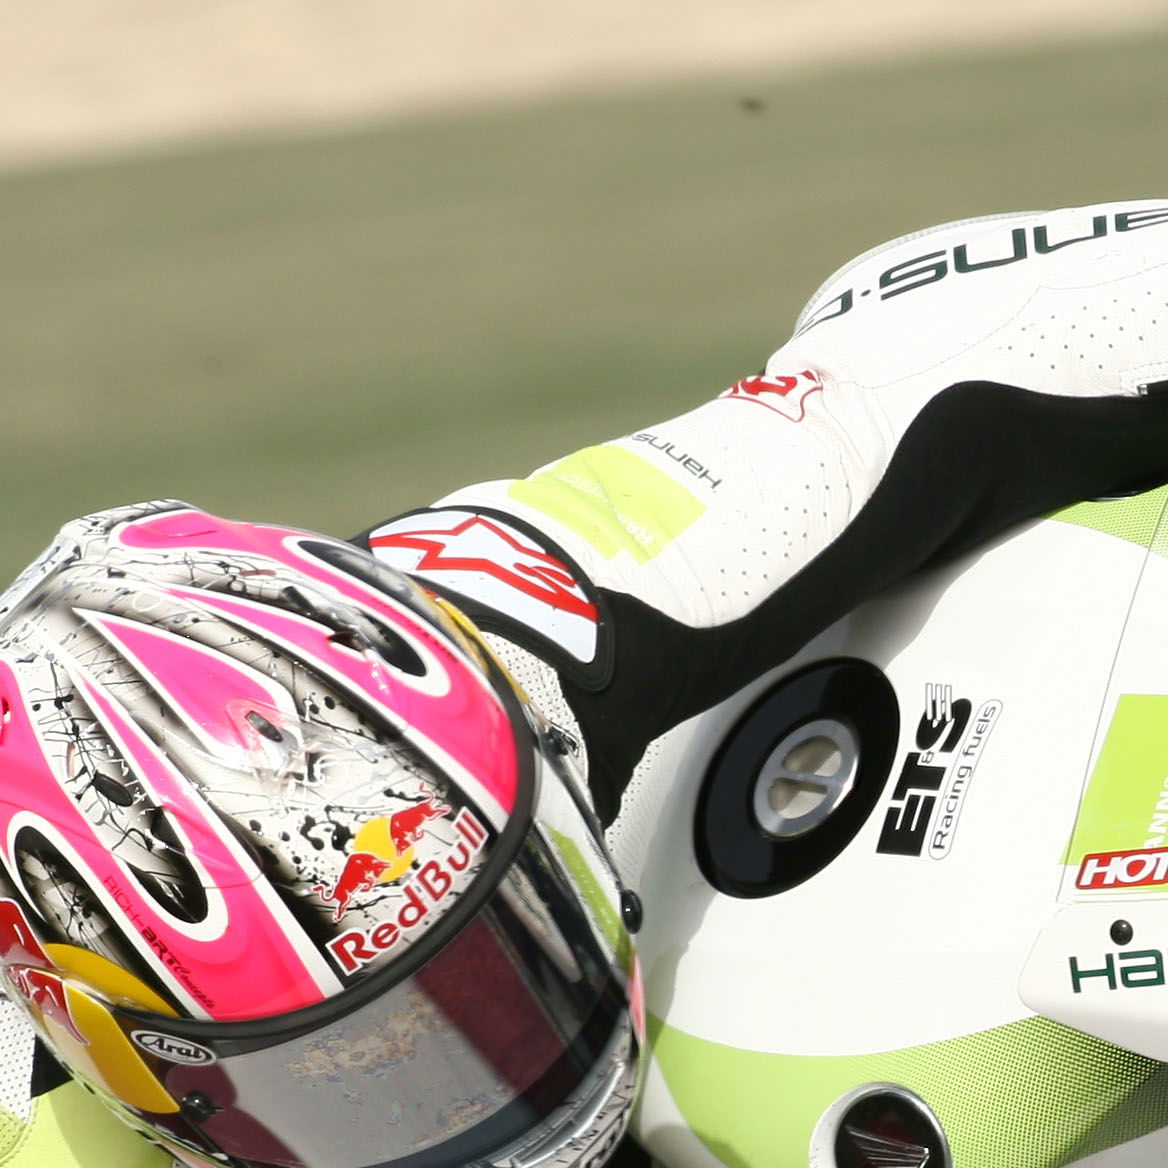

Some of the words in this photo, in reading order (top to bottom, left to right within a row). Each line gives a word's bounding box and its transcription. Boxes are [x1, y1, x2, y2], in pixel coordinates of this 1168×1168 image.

[932, 764, 973, 850] Racing
[962, 705, 997, 757] fuels
[330, 884, 430, 973] Red
[416, 810, 488, 902] Bull
